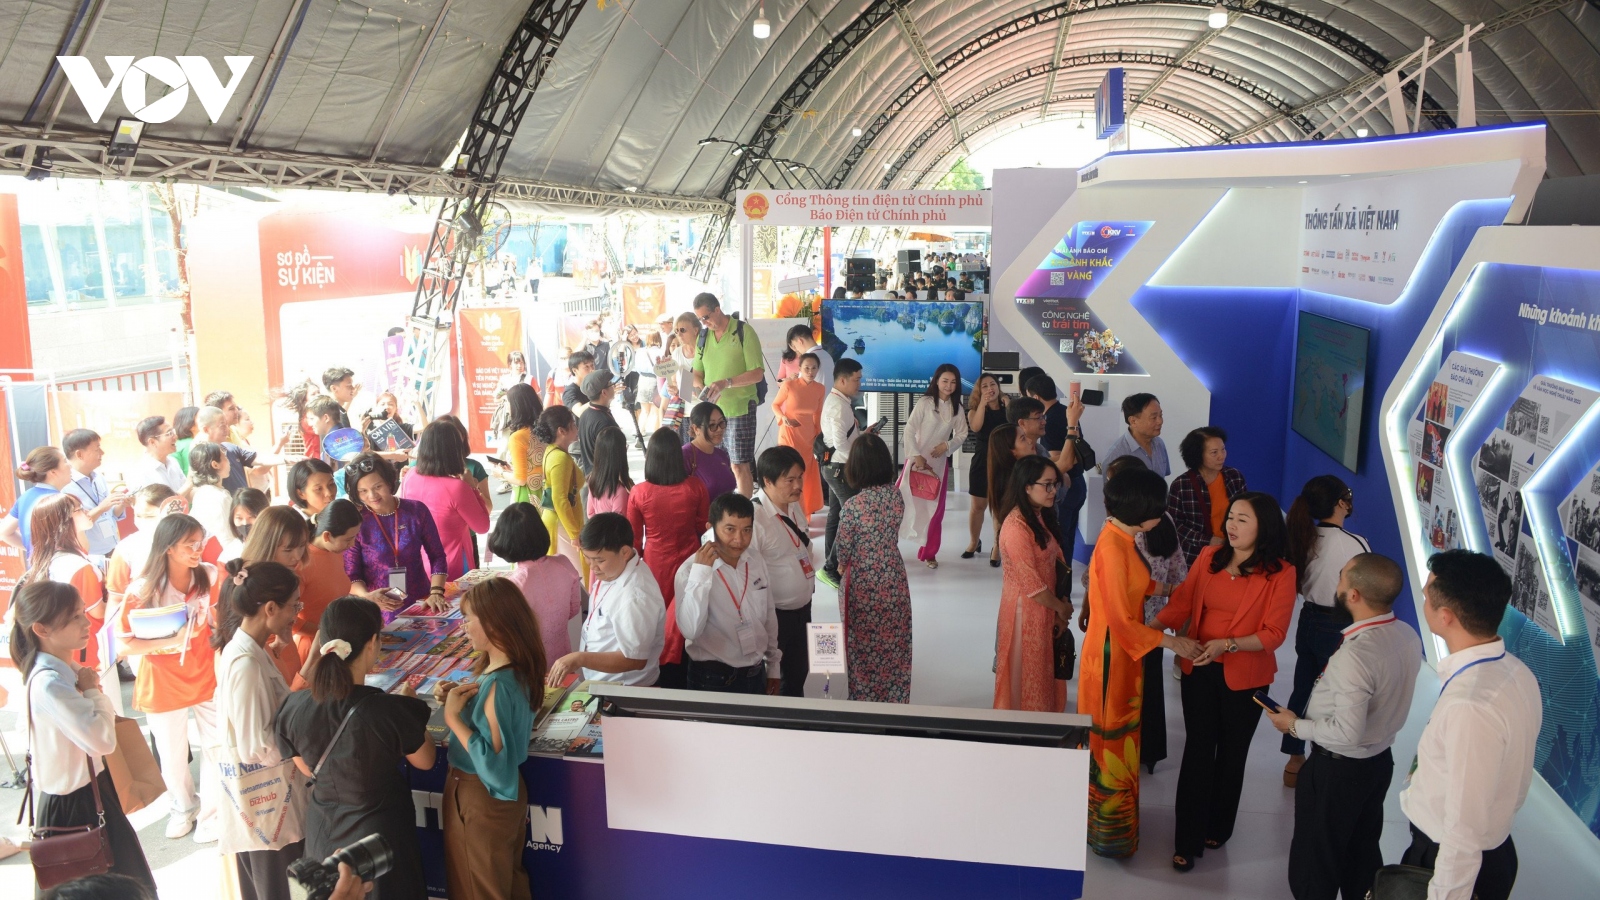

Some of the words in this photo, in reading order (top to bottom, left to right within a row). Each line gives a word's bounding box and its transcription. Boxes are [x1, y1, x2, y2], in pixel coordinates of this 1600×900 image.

[775, 193, 806, 208] Cổng
[810, 194, 849, 208] Thông
[852, 194, 869, 206] tin
[872, 193, 899, 208] điện
[902, 193, 916, 206] tử
[918, 193, 956, 206] Chính
[958, 193, 983, 208] phủ
[810, 209, 833, 220] Báo
[835, 209, 863, 223] Điện
[866, 209, 880, 220] tử
[882, 209, 919, 220] Chính
[922, 209, 947, 223] phủ
[1305, 208, 1328, 230] THÔNG
[1329, 203, 1344, 230] TẤN
[1358, 205, 1376, 236] VIỆT
[1376, 210, 1399, 230] NAM
[277, 251, 293, 266] SƠ
[295, 244, 311, 268] ĐỒ
[1083, 246, 1096, 254] BÁO
[1096, 246, 1108, 254] CHÍ
[1089, 256, 1113, 267] KHẮC
[278, 266, 299, 290] SỰ
[302, 261, 335, 289] KIỆN
[1066, 270, 1092, 280] VÀNG
[1041, 310, 1065, 319] CÔNG
[1066, 311, 1090, 320] NGHỆ
[1518, 303, 1548, 325] Những
[1549, 307, 1587, 329] khoảnh
[1041, 321, 1050, 329] từ
[1052, 319, 1070, 329] trái
[1072, 320, 1090, 329] tim
[1451, 363, 1460, 371] CÁC
[218, 762, 237, 779] Việt
[240, 777, 281, 795] vietnamnews.vn
[526, 840, 562, 853] Agency
